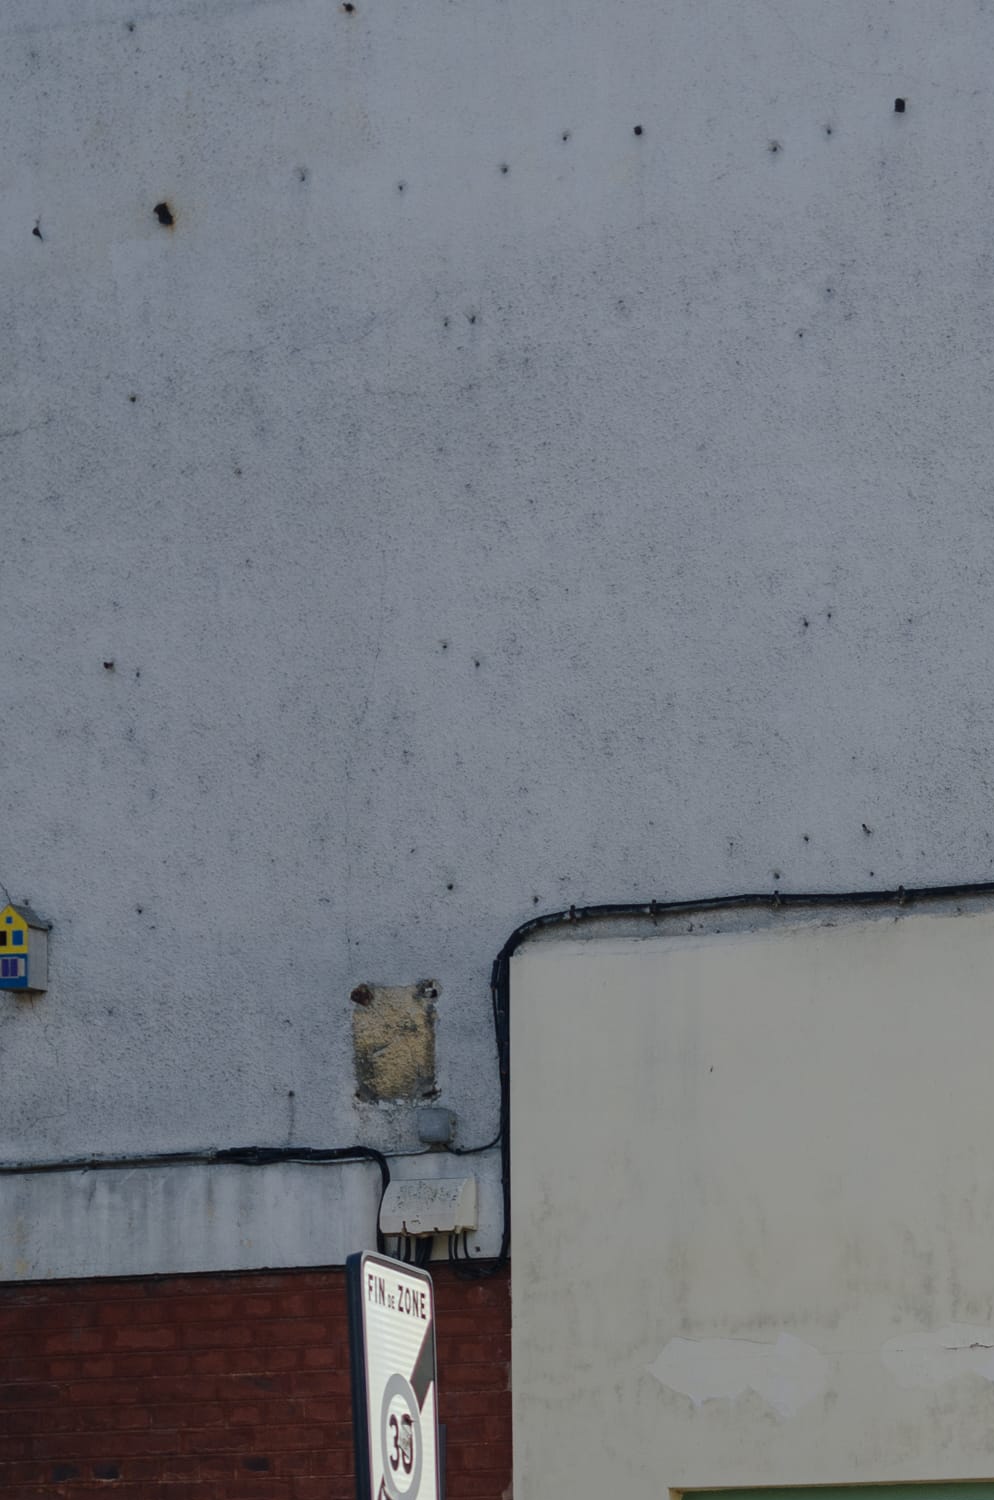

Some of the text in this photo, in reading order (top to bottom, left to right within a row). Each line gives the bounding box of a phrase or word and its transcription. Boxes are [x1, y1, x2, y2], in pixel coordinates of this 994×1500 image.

[368, 1273, 386, 1306] FIN
[398, 1285, 426, 1320] ZONE
[389, 1413, 414, 1475] 30
